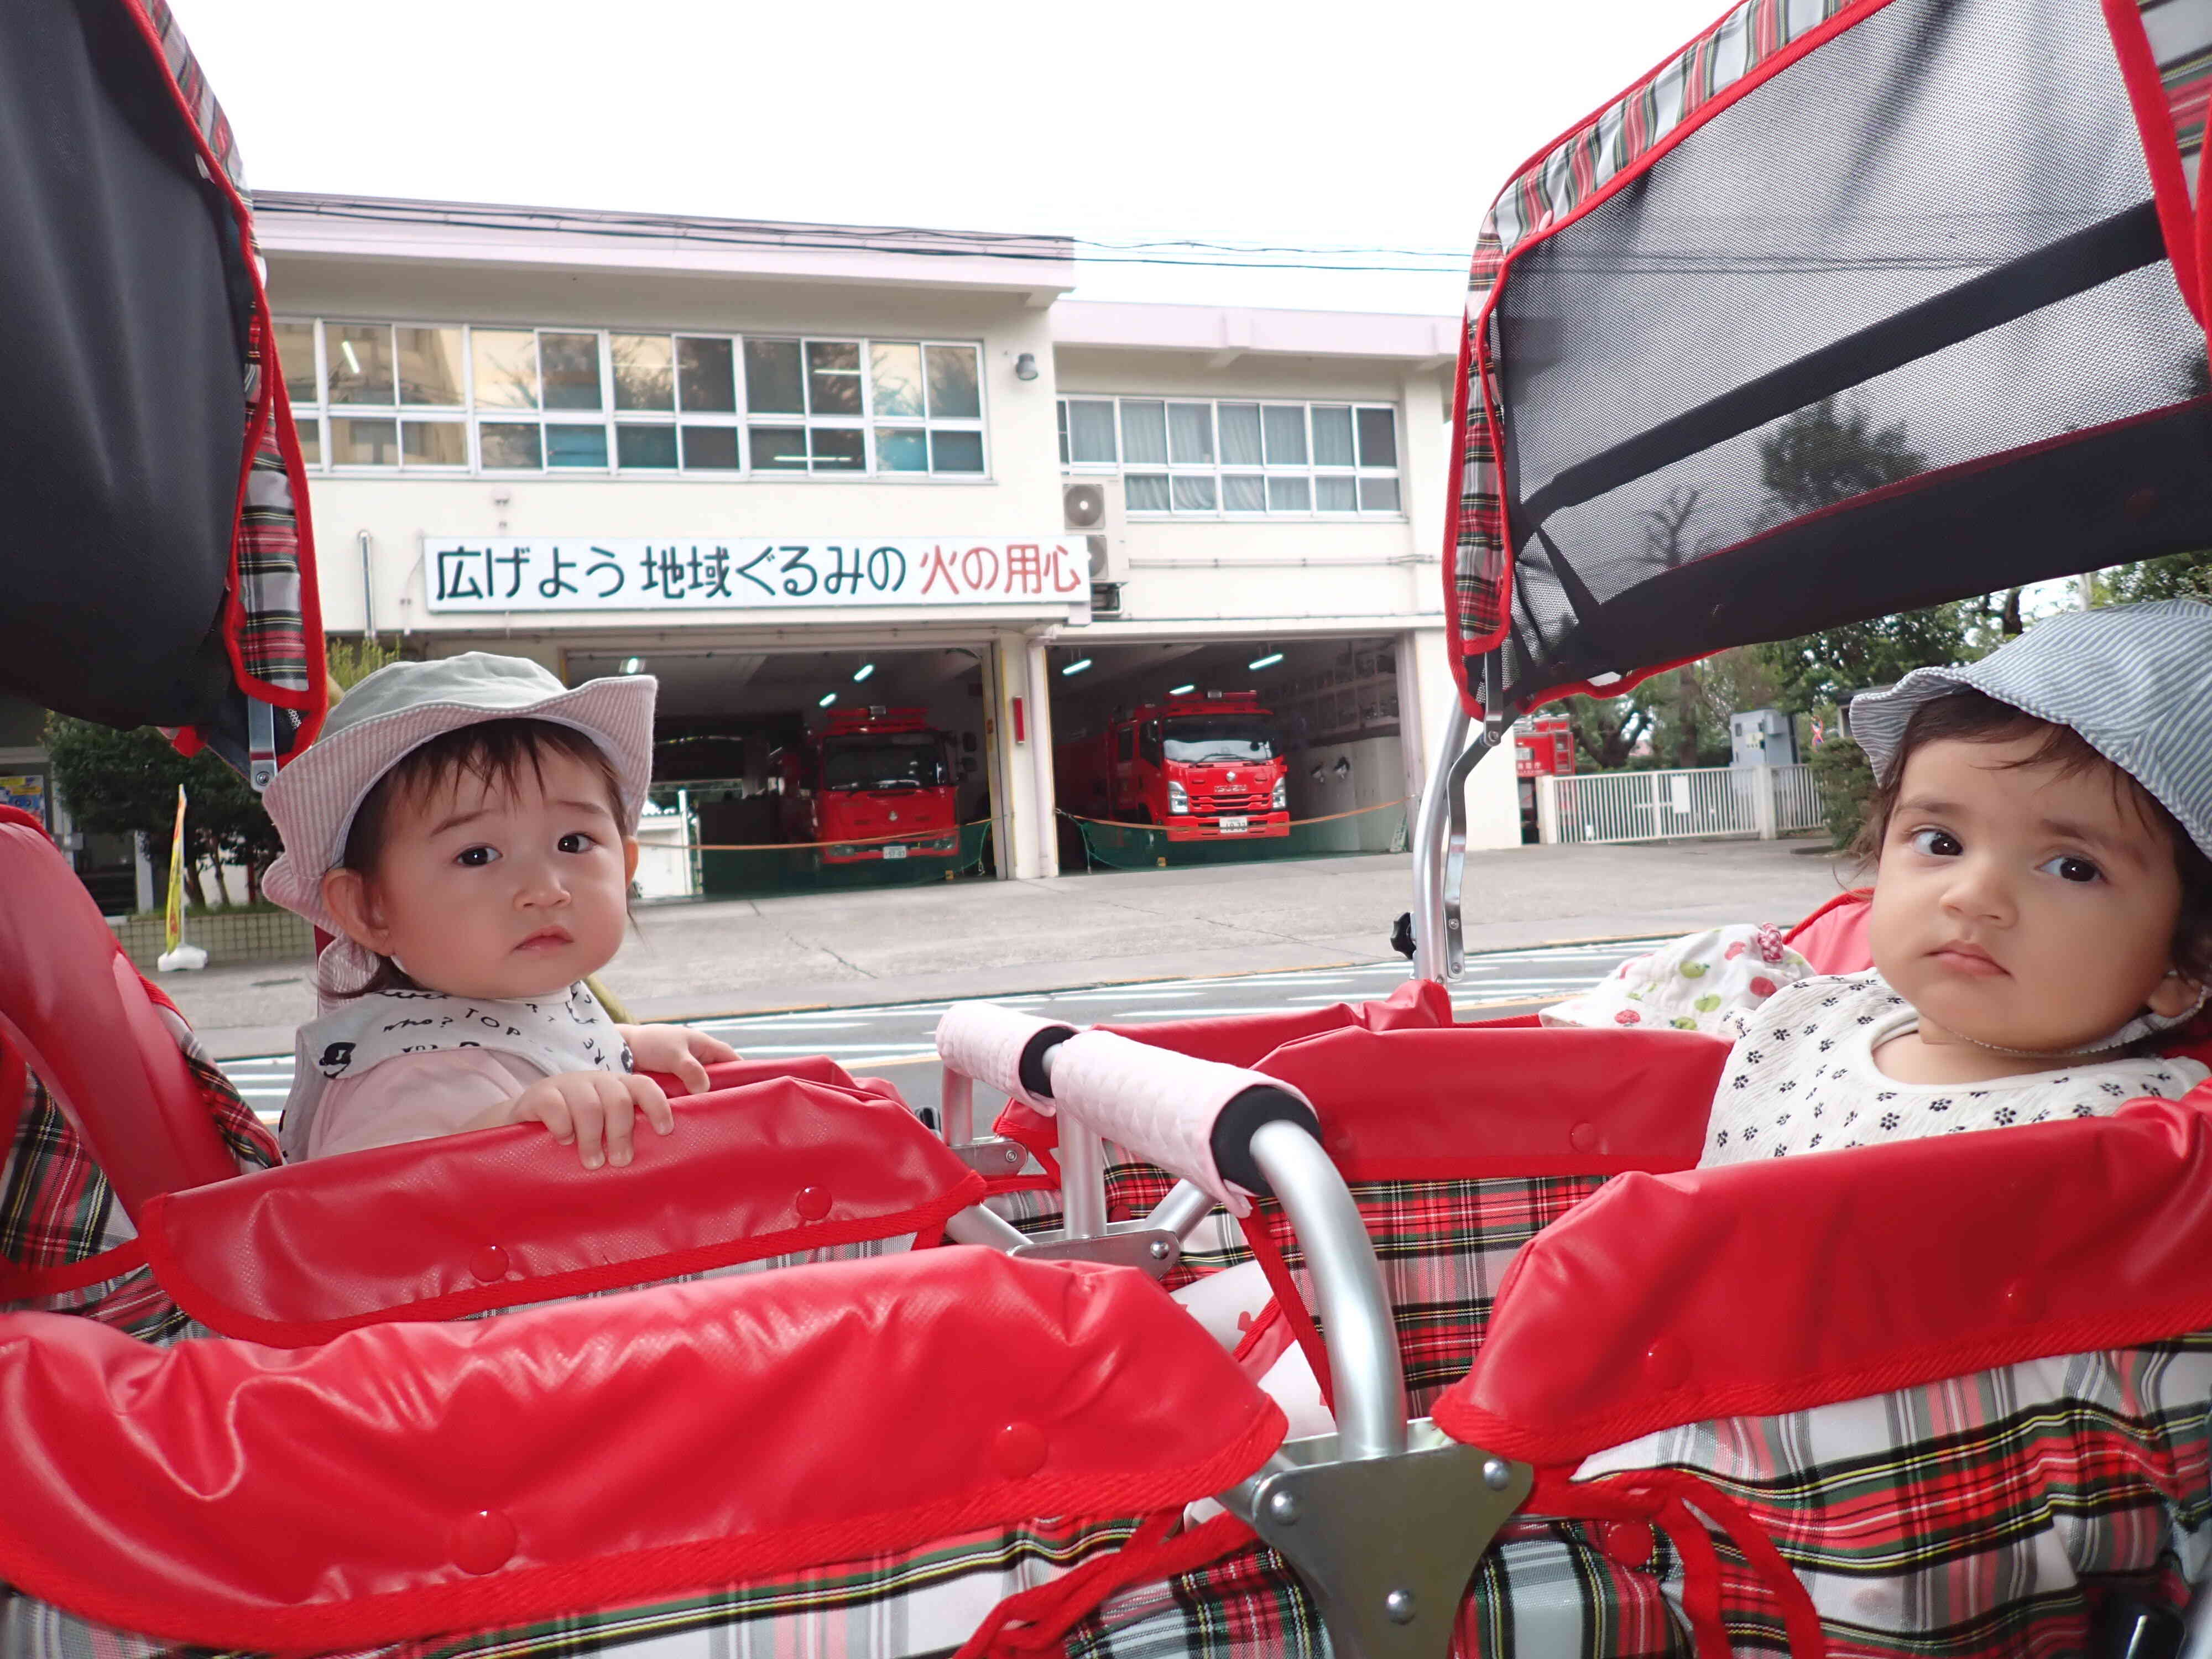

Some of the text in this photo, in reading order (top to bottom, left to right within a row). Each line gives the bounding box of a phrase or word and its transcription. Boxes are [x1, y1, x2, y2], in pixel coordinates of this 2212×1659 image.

[436, 544, 1081, 601] 広げよう 地域ぐるみの 火の用心
[1214, 784, 1248, 792] ISUZU
